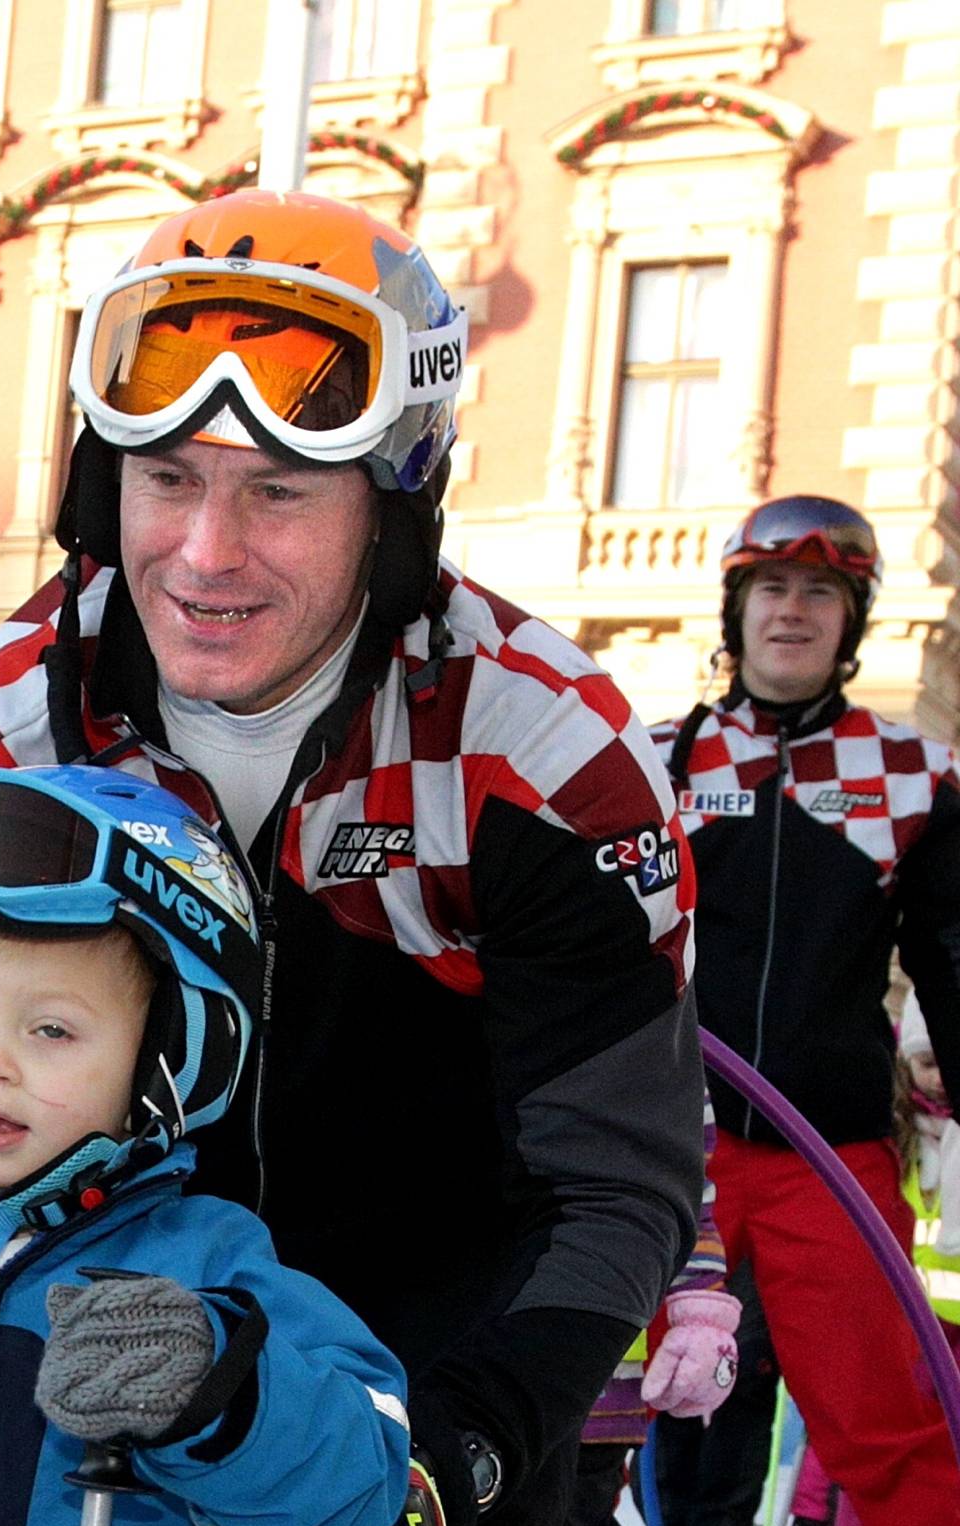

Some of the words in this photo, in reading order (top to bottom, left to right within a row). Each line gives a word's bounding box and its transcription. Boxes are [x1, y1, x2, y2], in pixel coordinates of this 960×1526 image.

[409, 337, 462, 388] uvex
[707, 793, 751, 811] HEP
[123, 848, 227, 955] uvex
